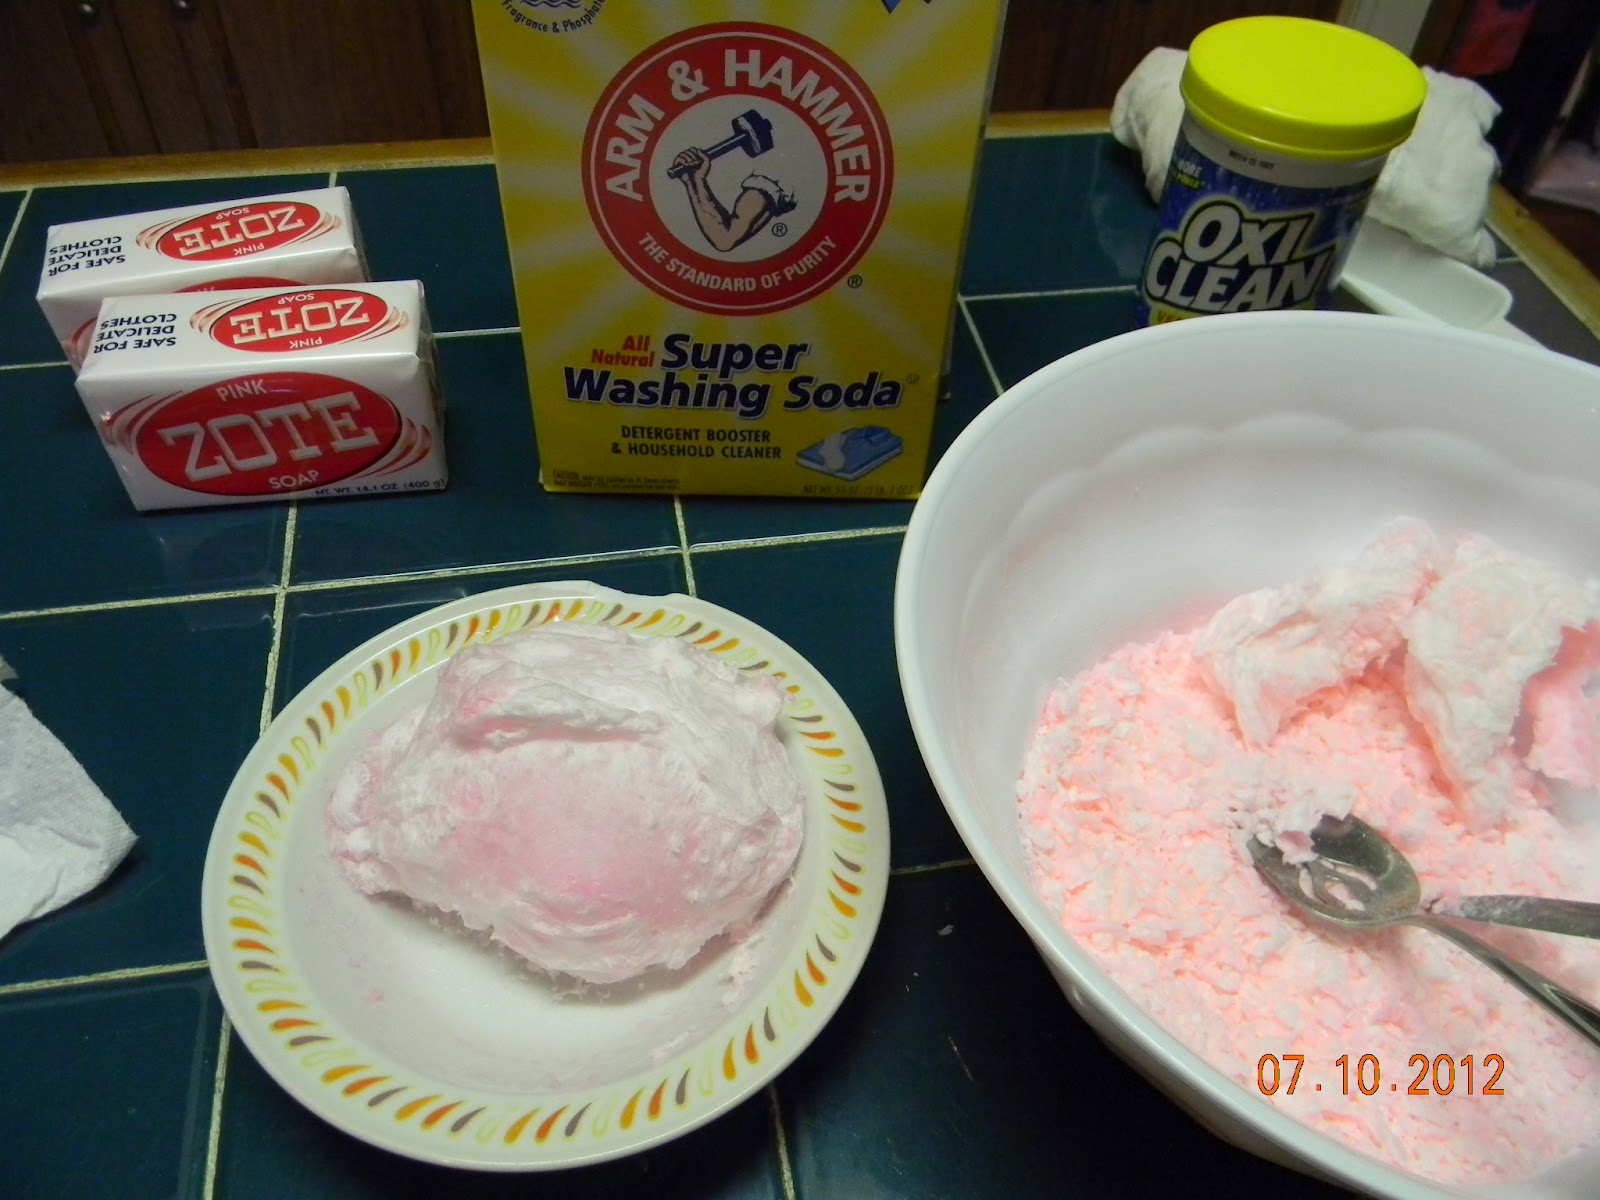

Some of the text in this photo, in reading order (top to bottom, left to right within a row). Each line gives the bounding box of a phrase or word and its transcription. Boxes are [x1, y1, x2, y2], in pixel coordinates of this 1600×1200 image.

[552, 22, 560, 33] &
[605, 49, 871, 203] ARM & HAMMER
[215, 207, 251, 221] SOAP
[174, 205, 306, 257] ZOTE
[1182, 200, 1315, 267] OXI
[49, 235, 123, 255] CLOTHES
[233, 242, 265, 256] PINK
[47, 246, 123, 267] DELICATE
[48, 254, 126, 277] SAFE FOR
[639, 232, 837, 292] THE STANDARD OF PURITY
[1146, 240, 1332, 312] CLEAN
[277, 292, 315, 305] SOAP
[99, 313, 178, 329] CLOTHES
[229, 297, 370, 345] ZOTE
[96, 325, 175, 342] DELICATE
[289, 336, 323, 350] PINK
[621, 335, 651, 351] All
[93, 337, 177, 355] SAFE FOR
[591, 348, 656, 368] Natural
[660, 333, 809, 380] Super
[216, 378, 269, 402] PINK
[562, 366, 903, 418] Washing Soda
[157, 391, 380, 483] ZOTE
[621, 425, 771, 442] DETERGENT BOOSTER
[611, 442, 782, 459] & HOUSEHOLD CLEANER
[268, 469, 320, 490] SOAP
[403, 479, 429, 489] (400
